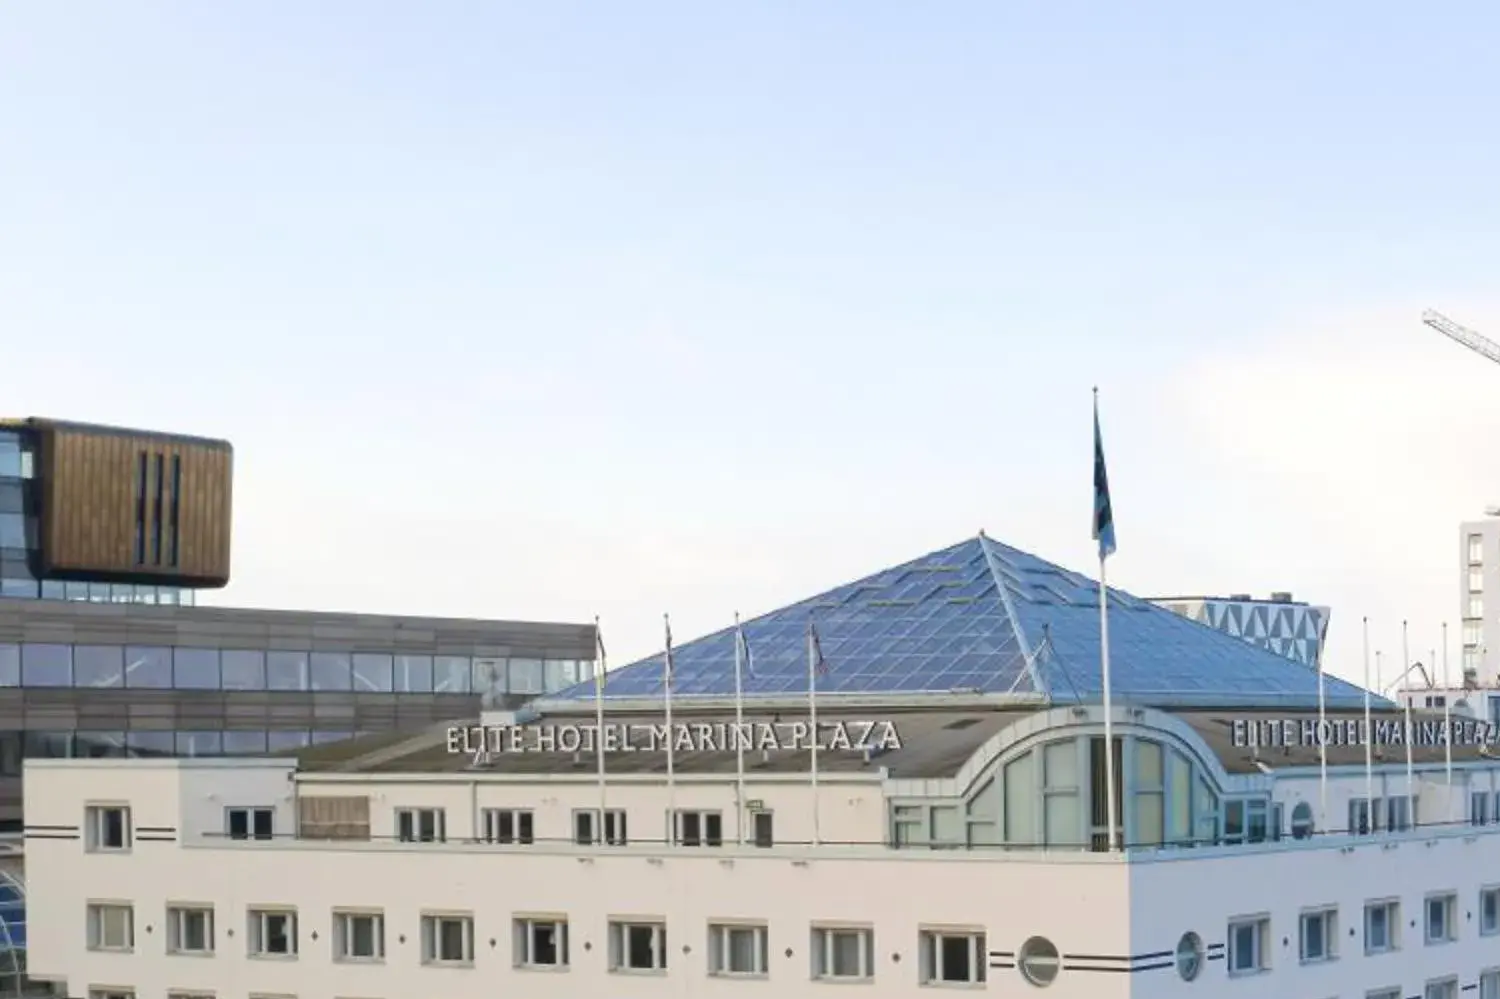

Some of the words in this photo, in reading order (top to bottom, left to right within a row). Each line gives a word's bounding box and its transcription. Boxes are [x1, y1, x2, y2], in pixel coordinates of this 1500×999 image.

[447, 726, 524, 753] ELITE
[536, 724, 636, 752] HOTEL
[651, 723, 780, 751] MARINA
[1301, 719, 1370, 745] HOTEL
